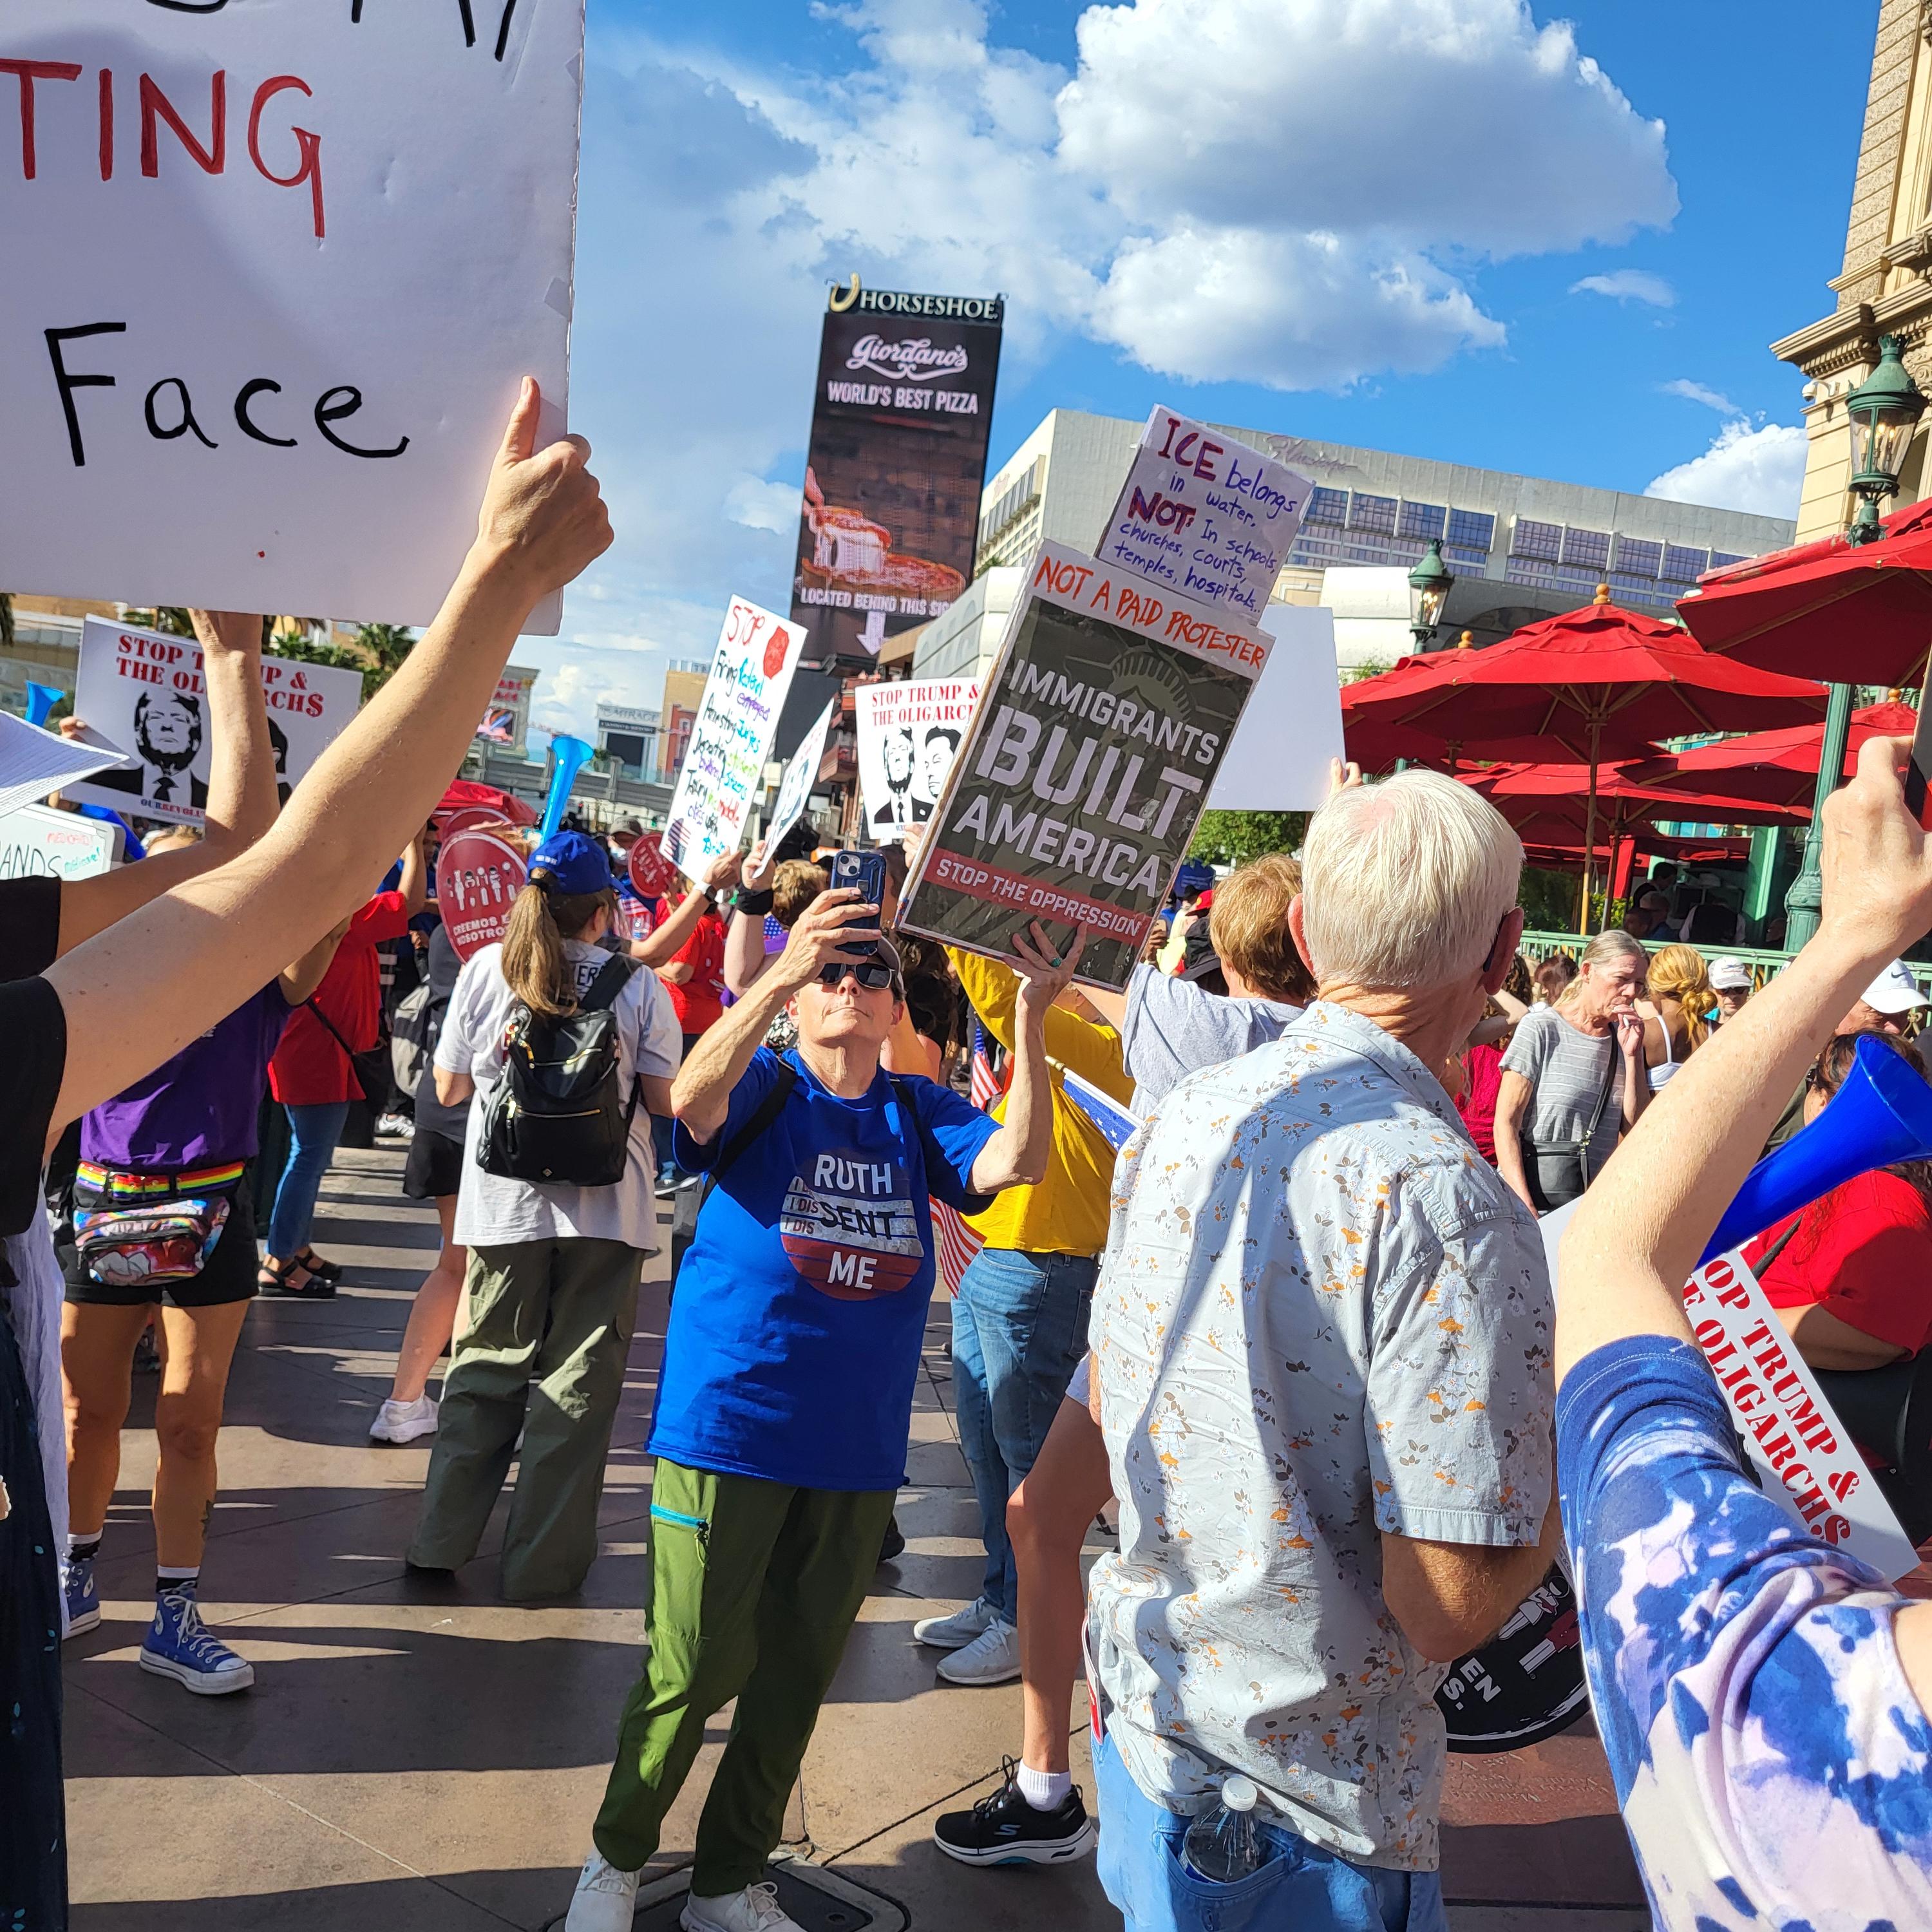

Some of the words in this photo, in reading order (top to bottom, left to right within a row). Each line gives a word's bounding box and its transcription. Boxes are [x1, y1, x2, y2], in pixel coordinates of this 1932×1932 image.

[860, 290, 997, 319] HORSESHOE
[845, 334, 968, 381] Giordano's
[44, 322, 410, 466] Face
[827, 380, 891, 407] WORLD'S
[894, 386, 933, 410] BEST
[934, 391, 978, 414] PIZZA
[1158, 418, 1224, 482] ICE
[1226, 459, 1297, 519] belongs
[1170, 471, 1184, 492] in
[1120, 520, 1184, 558] churches,
[1200, 519, 1217, 544] In
[1114, 540, 1177, 585] temples,
[800, 587, 851, 607] LOCATED
[854, 592, 896, 612] BEHIND
[900, 597, 927, 615] THIS
[1034, 556, 1094, 600] NOT
[1091, 580, 1111, 611] A
[1115, 589, 1163, 626] PAID
[1164, 611, 1266, 670] PROTESTER
[118, 634, 183, 665] STOP
[117, 656, 165, 686] THE
[290, 671, 308, 691] &
[872, 690, 902, 707] STOP
[908, 684, 961, 703] TRUMP
[1008, 658, 1220, 766] IMMIGRANTS
[873, 708, 895, 726] THE
[974, 705, 1204, 840] BUILT
[952, 794, 1161, 898] AMERICA
[936, 858, 989, 889] STOP
[992, 875, 1029, 902] THE
[1030, 888, 1142, 937] OPPRESSION
[814, 1154, 893, 1195] RUTH
[820, 1201, 896, 1240] SENT
[827, 1251, 878, 1291] ME
[1741, 1318, 1837, 1455] TRUMP
[1828, 1470, 1860, 1503] &
[1695, 1318, 1852, 1546] OLIGARCHS
